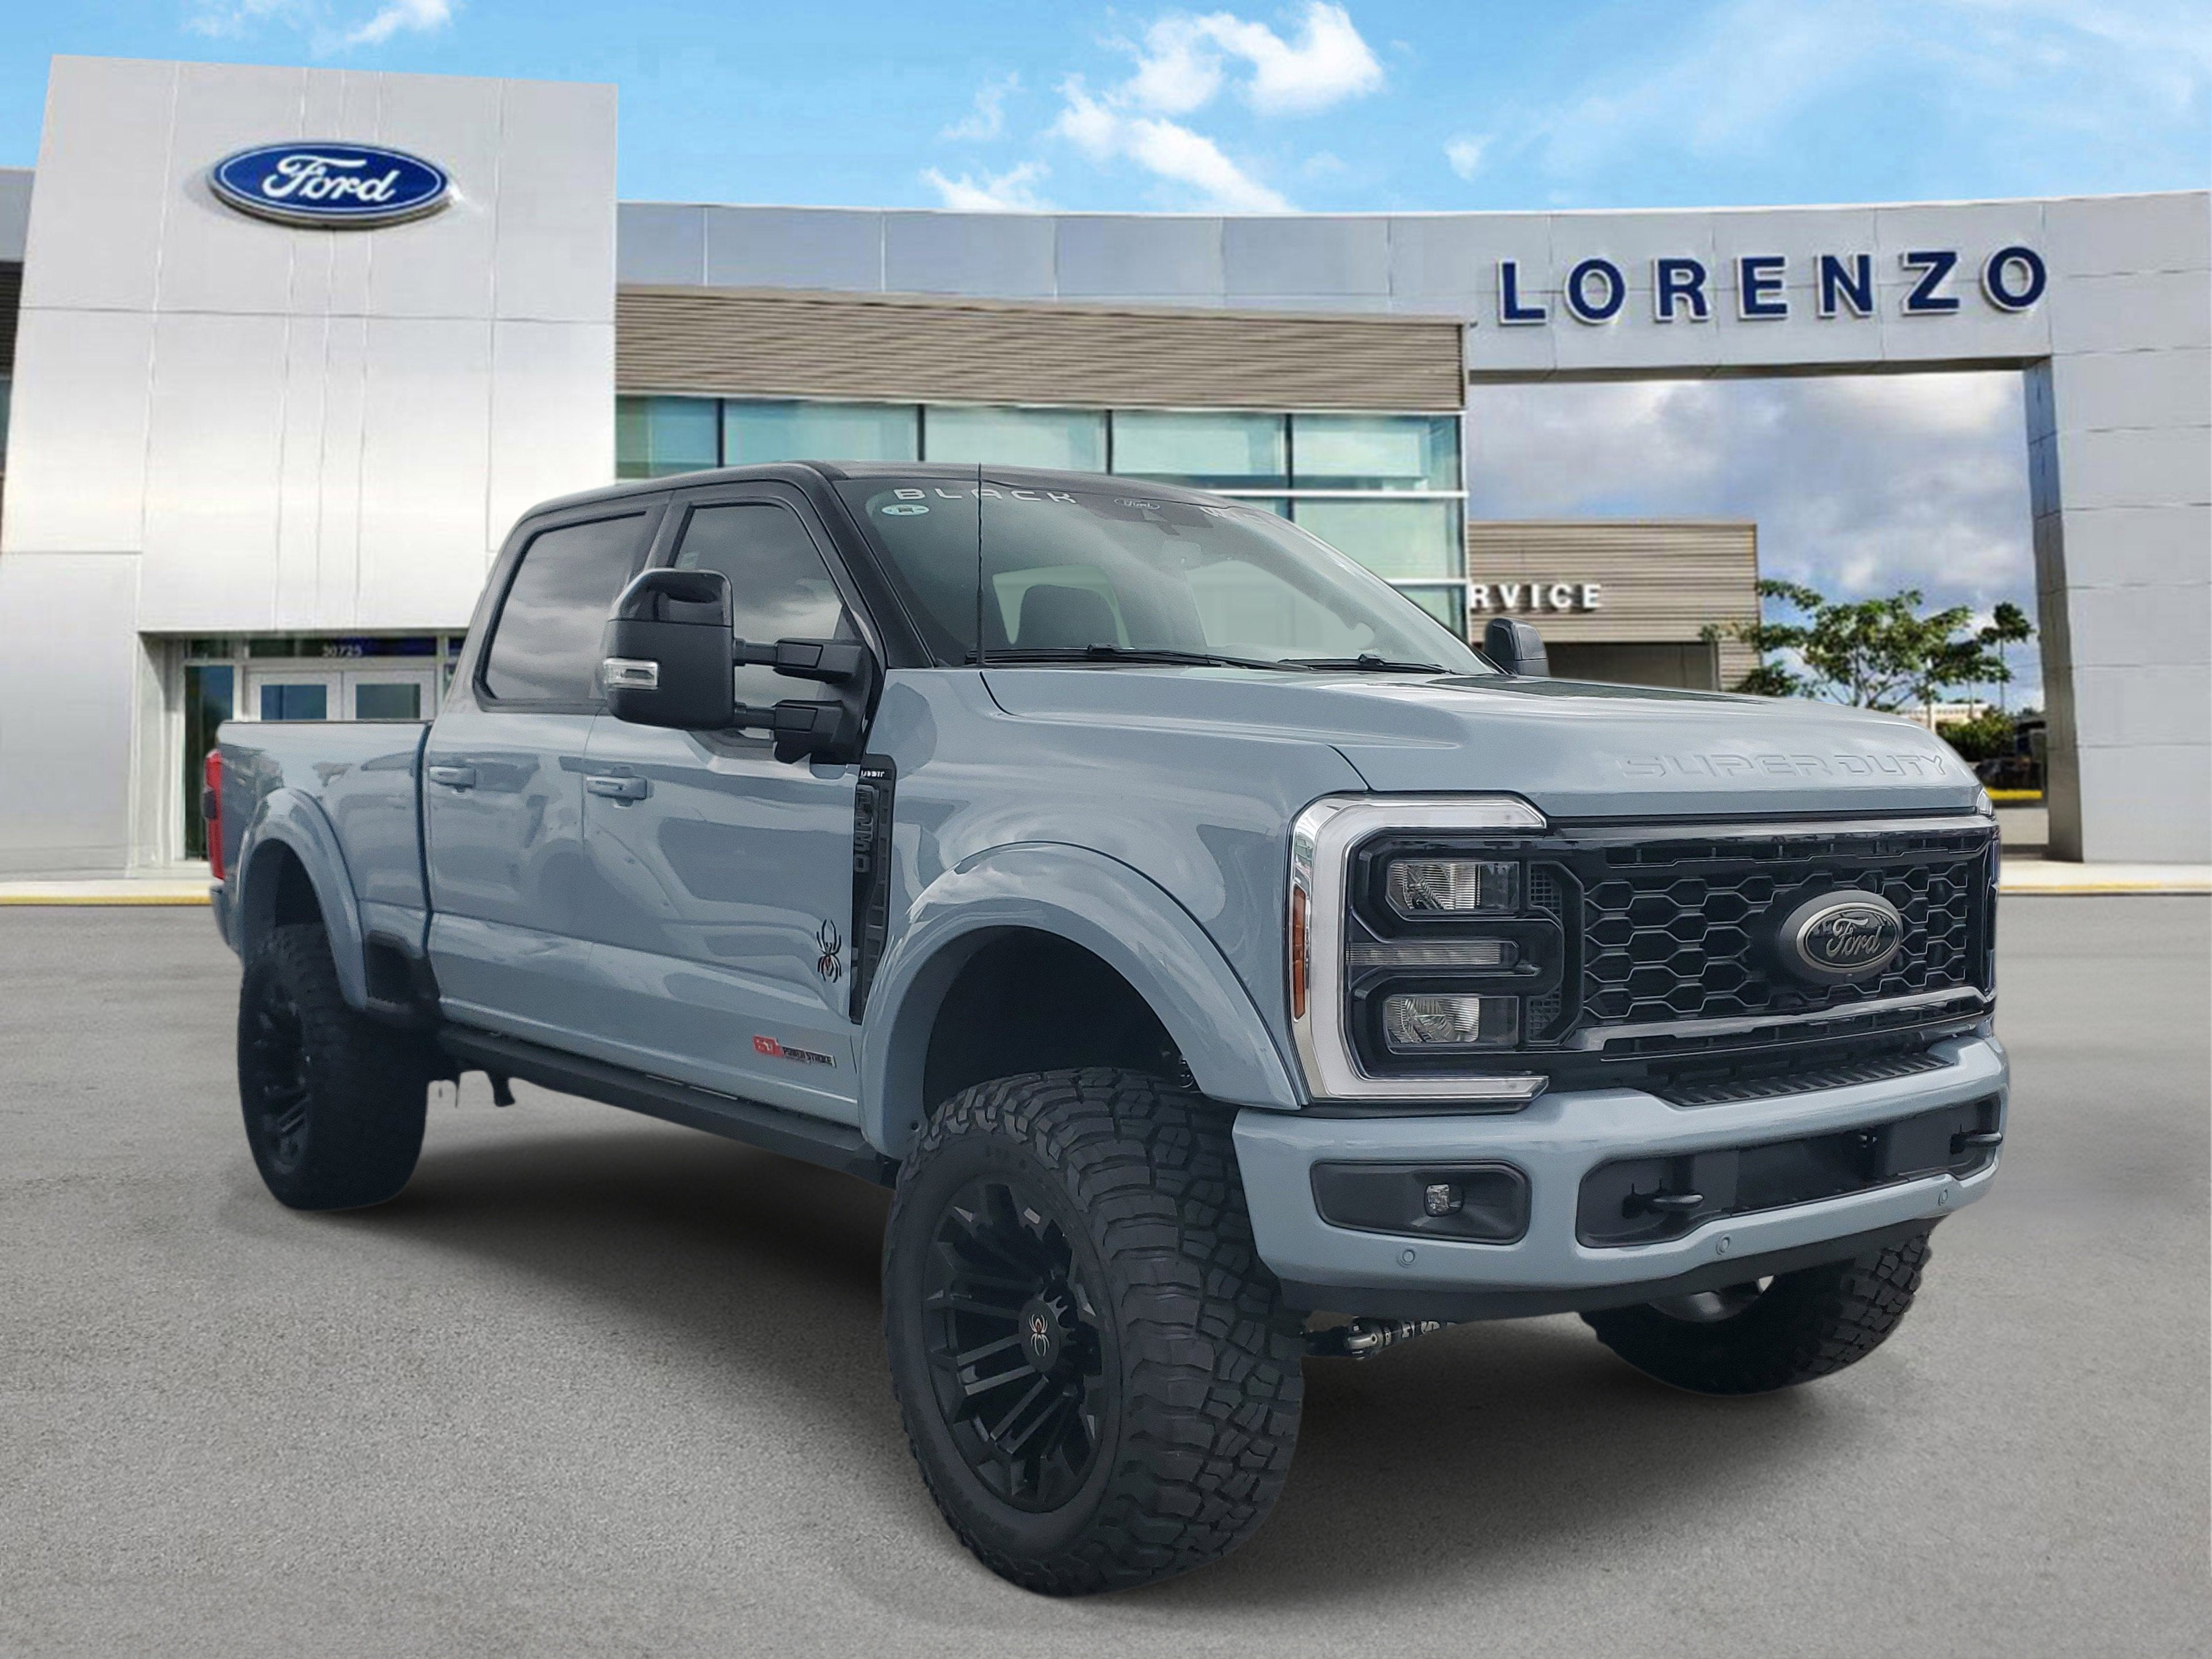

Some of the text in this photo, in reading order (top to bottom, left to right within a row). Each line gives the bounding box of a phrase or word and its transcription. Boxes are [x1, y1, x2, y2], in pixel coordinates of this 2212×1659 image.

[262, 154, 400, 202] Ford
[1497, 246, 2047, 326] LORENZO
[893, 488, 1077, 504] BLACK
[1470, 583, 1602, 609] RVICE
[1615, 753, 1946, 778] SUPER DUTY
[1825, 917, 1882, 958] Ford
